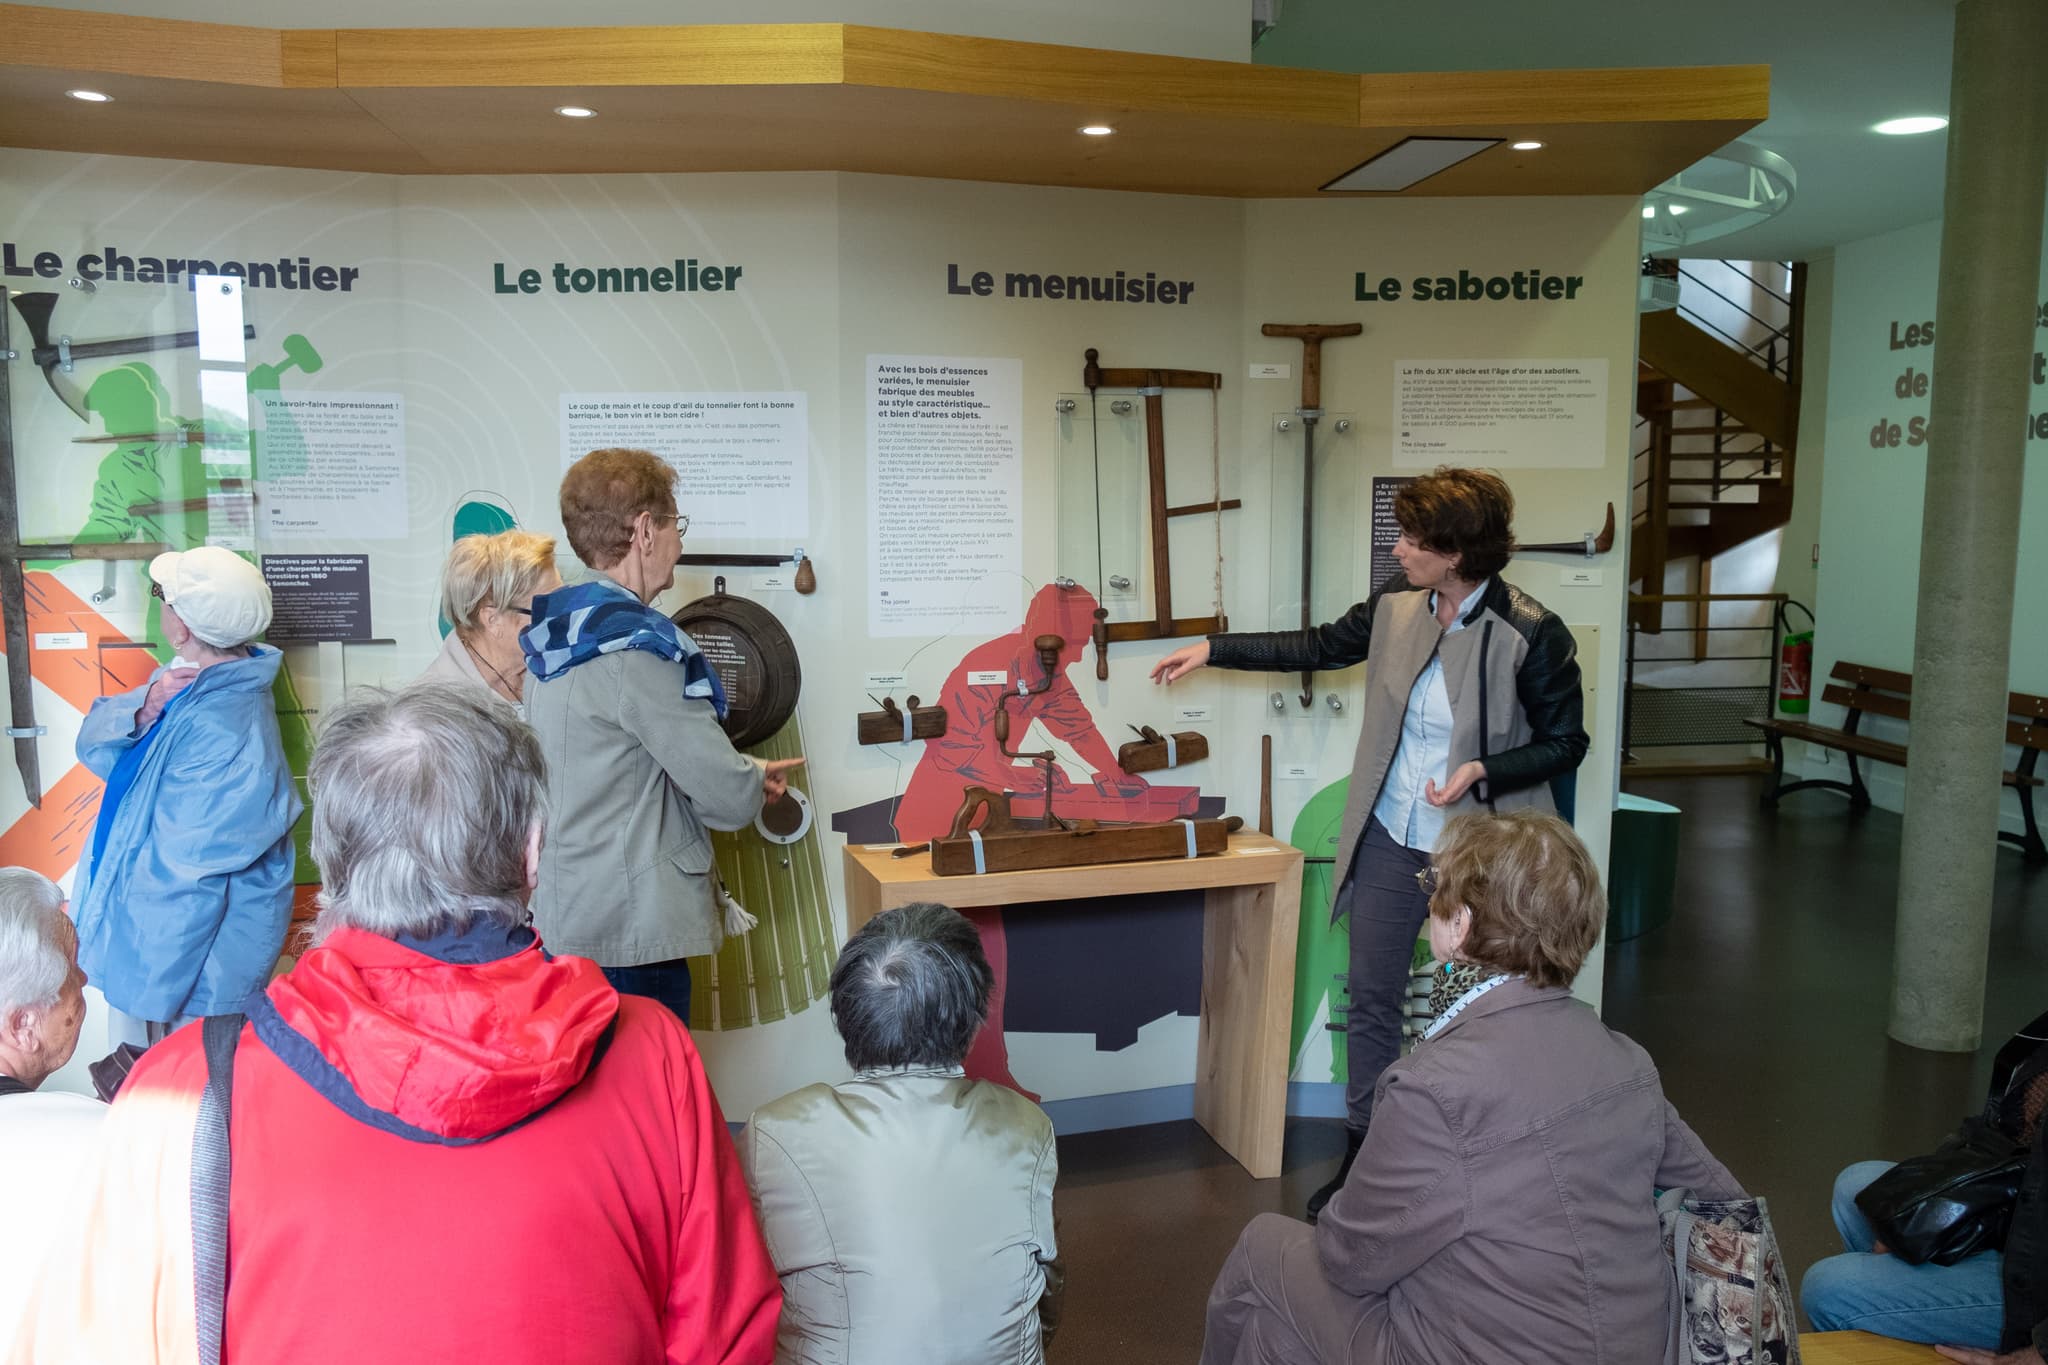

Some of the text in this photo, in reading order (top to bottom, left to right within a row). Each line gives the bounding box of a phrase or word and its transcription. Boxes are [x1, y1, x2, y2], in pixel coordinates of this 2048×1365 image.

[2, 242, 359, 292] Le charpentier
[494, 259, 742, 294] Le tonnelier
[948, 264, 1194, 304] Le menuisier
[1354, 269, 1584, 302] Le sabotier
[1890, 321, 1935, 351] Les
[878, 365, 902, 373] Avec
[940, 367, 988, 375] d'essences
[878, 377, 914, 387] variées,
[926, 378, 970, 386] menuisier
[1895, 368, 1928, 399] de
[878, 388, 917, 398] fabrique
[937, 389, 975, 397] meubles
[329, 401, 394, 411] impressionnant
[891, 399, 914, 408] style
[916, 399, 990, 410] caractéristique...
[569, 412, 603, 420] barrique,
[912, 410, 949, 418] d'autres
[950, 411, 981, 421] objets.
[1870, 418, 1902, 448] de
